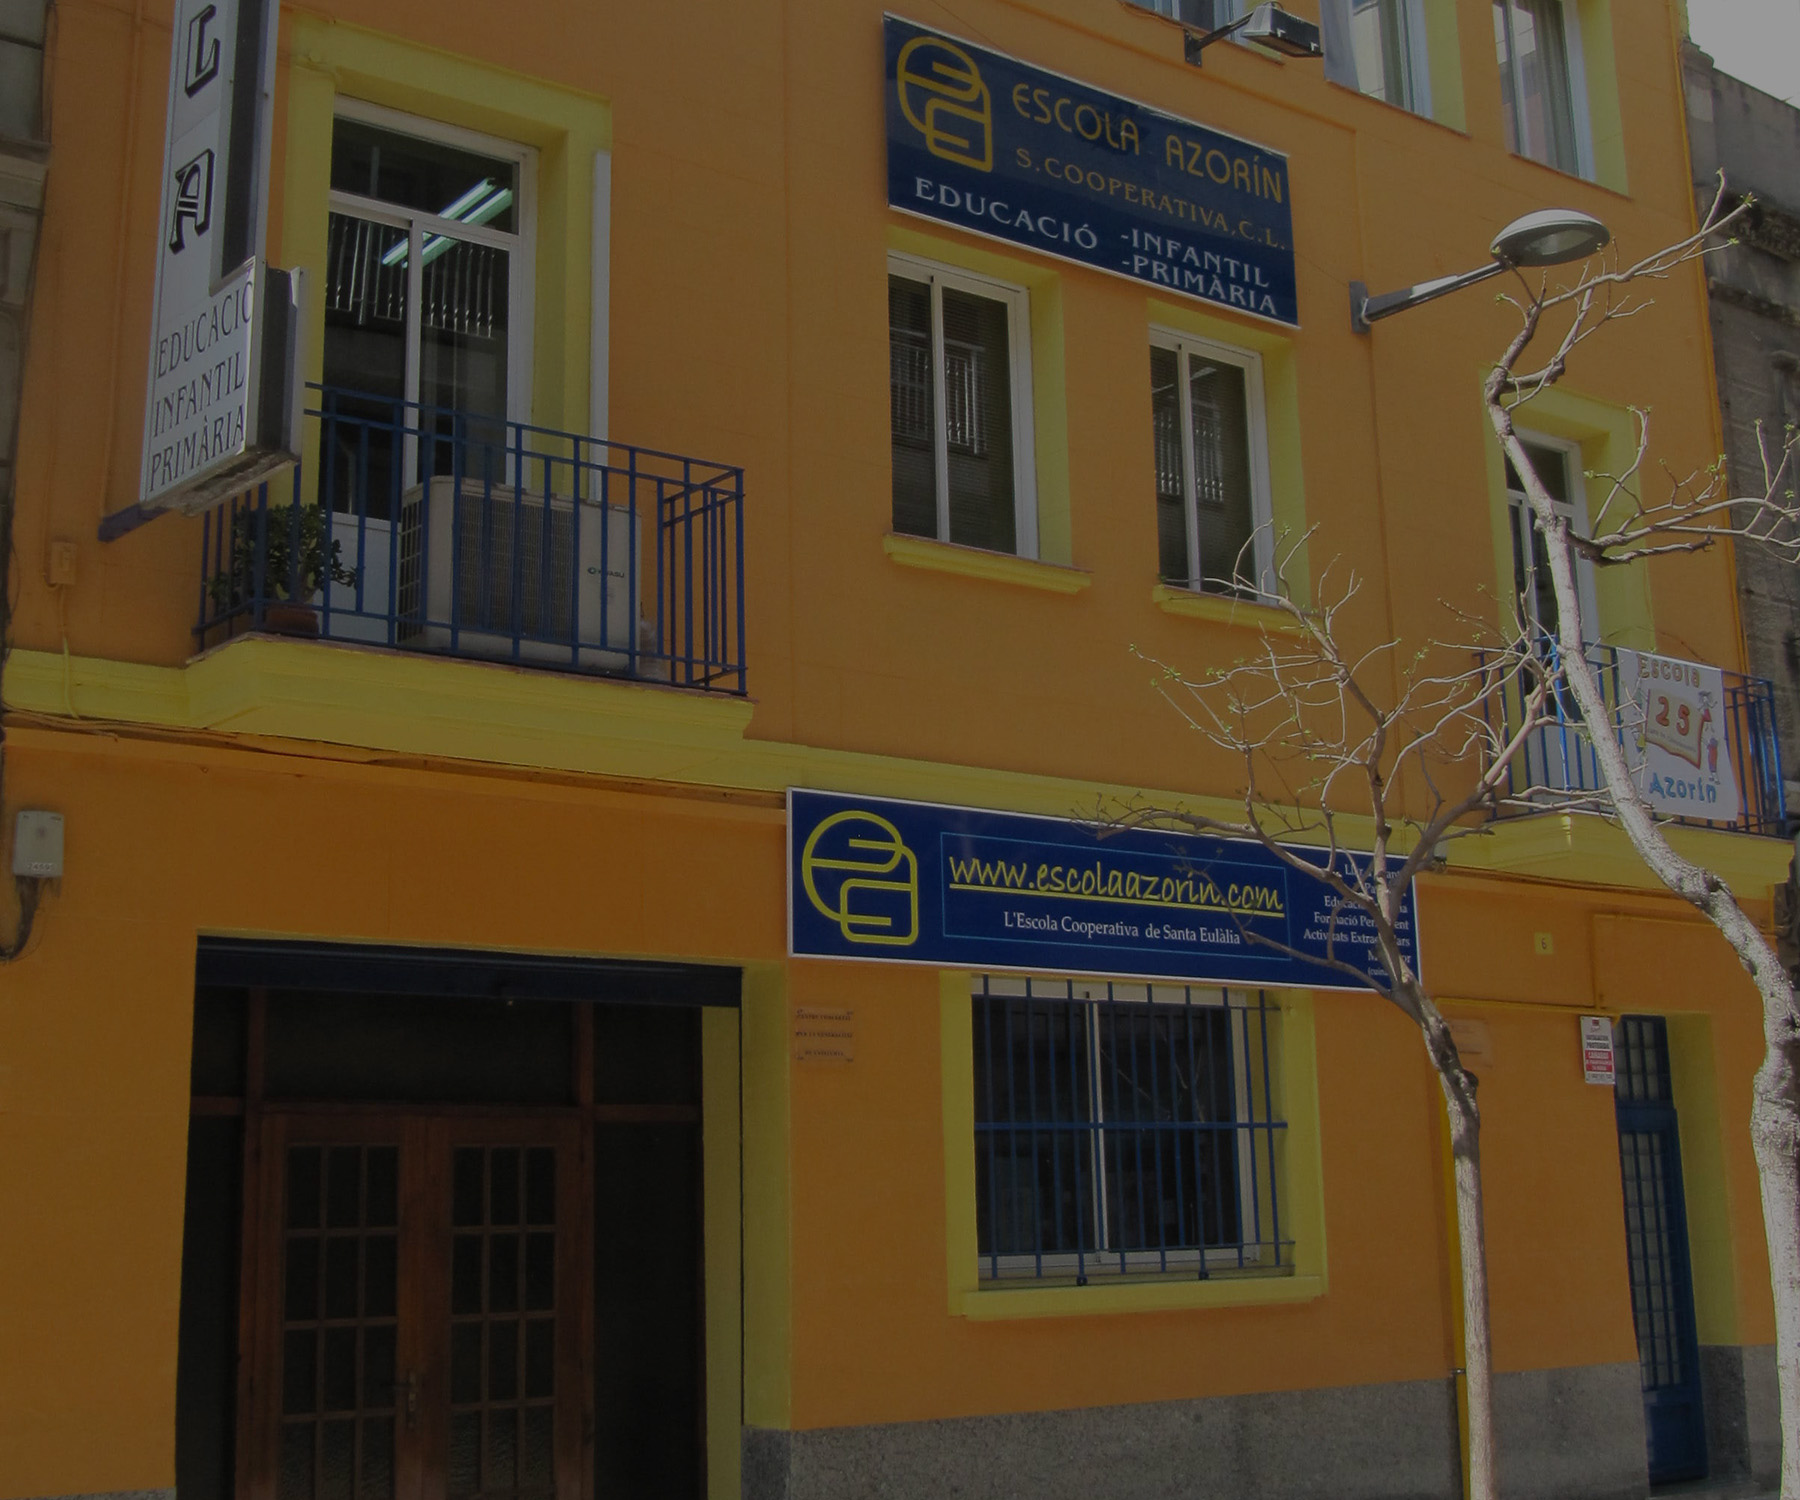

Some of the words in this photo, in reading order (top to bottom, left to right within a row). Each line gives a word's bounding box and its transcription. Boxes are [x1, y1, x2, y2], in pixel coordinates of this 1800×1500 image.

[1012, 82, 1141, 156] ESCOLA
[1165, 135, 1282, 204] AZORÍN
[916, 176, 1099, 250] EDUCACIÓ
[153, 351, 245, 438] INFANTIL
[149, 403, 245, 493] PRIMÀRIA
[1655, 696, 1690, 736] 25
[949, 856, 1284, 911] www.escolaazorin.com
[1003, 911, 1058, 931] L'Escola
[1061, 915, 1140, 940] Cooperativa
[1144, 922, 1161, 939] de
[1163, 923, 1197, 942] Santa
[1199, 926, 1241, 945] Eulàlia
[1303, 928, 1349, 943] Activtats
